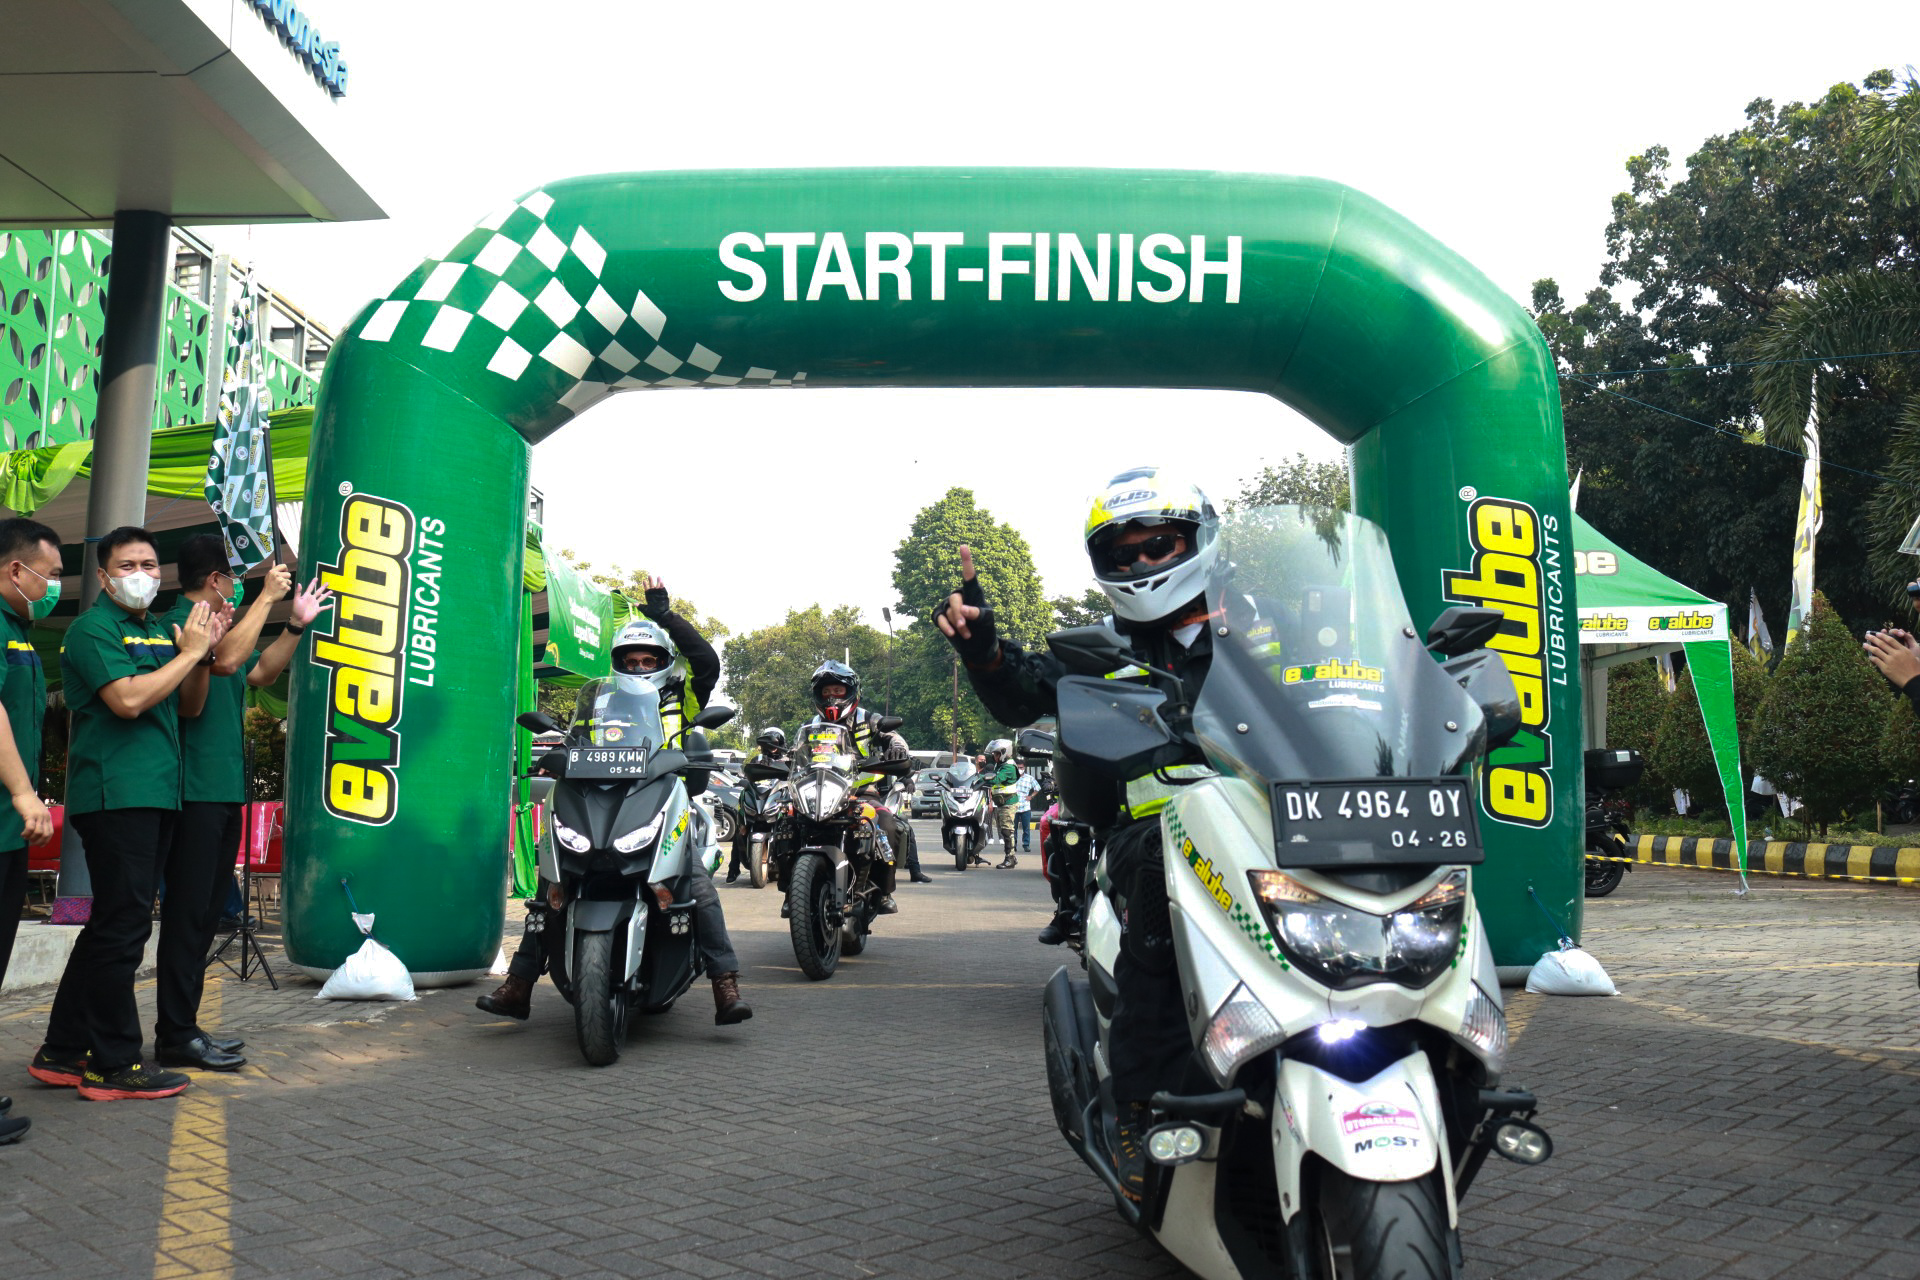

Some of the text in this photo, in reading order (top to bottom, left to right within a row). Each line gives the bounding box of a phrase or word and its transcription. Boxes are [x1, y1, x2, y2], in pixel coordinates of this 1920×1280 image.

[717, 231, 1243, 303] START-FINISH
[409, 516, 446, 687] LUBRICANTS
[1543, 513, 1568, 686] LUBRICANTS
[1648, 611, 1714, 631] evalube
[314, 499, 407, 822] evalube
[1284, 658, 1383, 684] evalube
[1328, 680, 1385, 693] LUBRICANTS
[571, 751, 644, 763] B 4989 KMW
[1286, 791, 1323, 821] DK
[1337, 789, 1410, 819] 4964
[1182, 837, 1233, 913] evalube
[84, 1071, 104, 1083] HOKA
[1354, 1135, 1420, 1154] MOST
